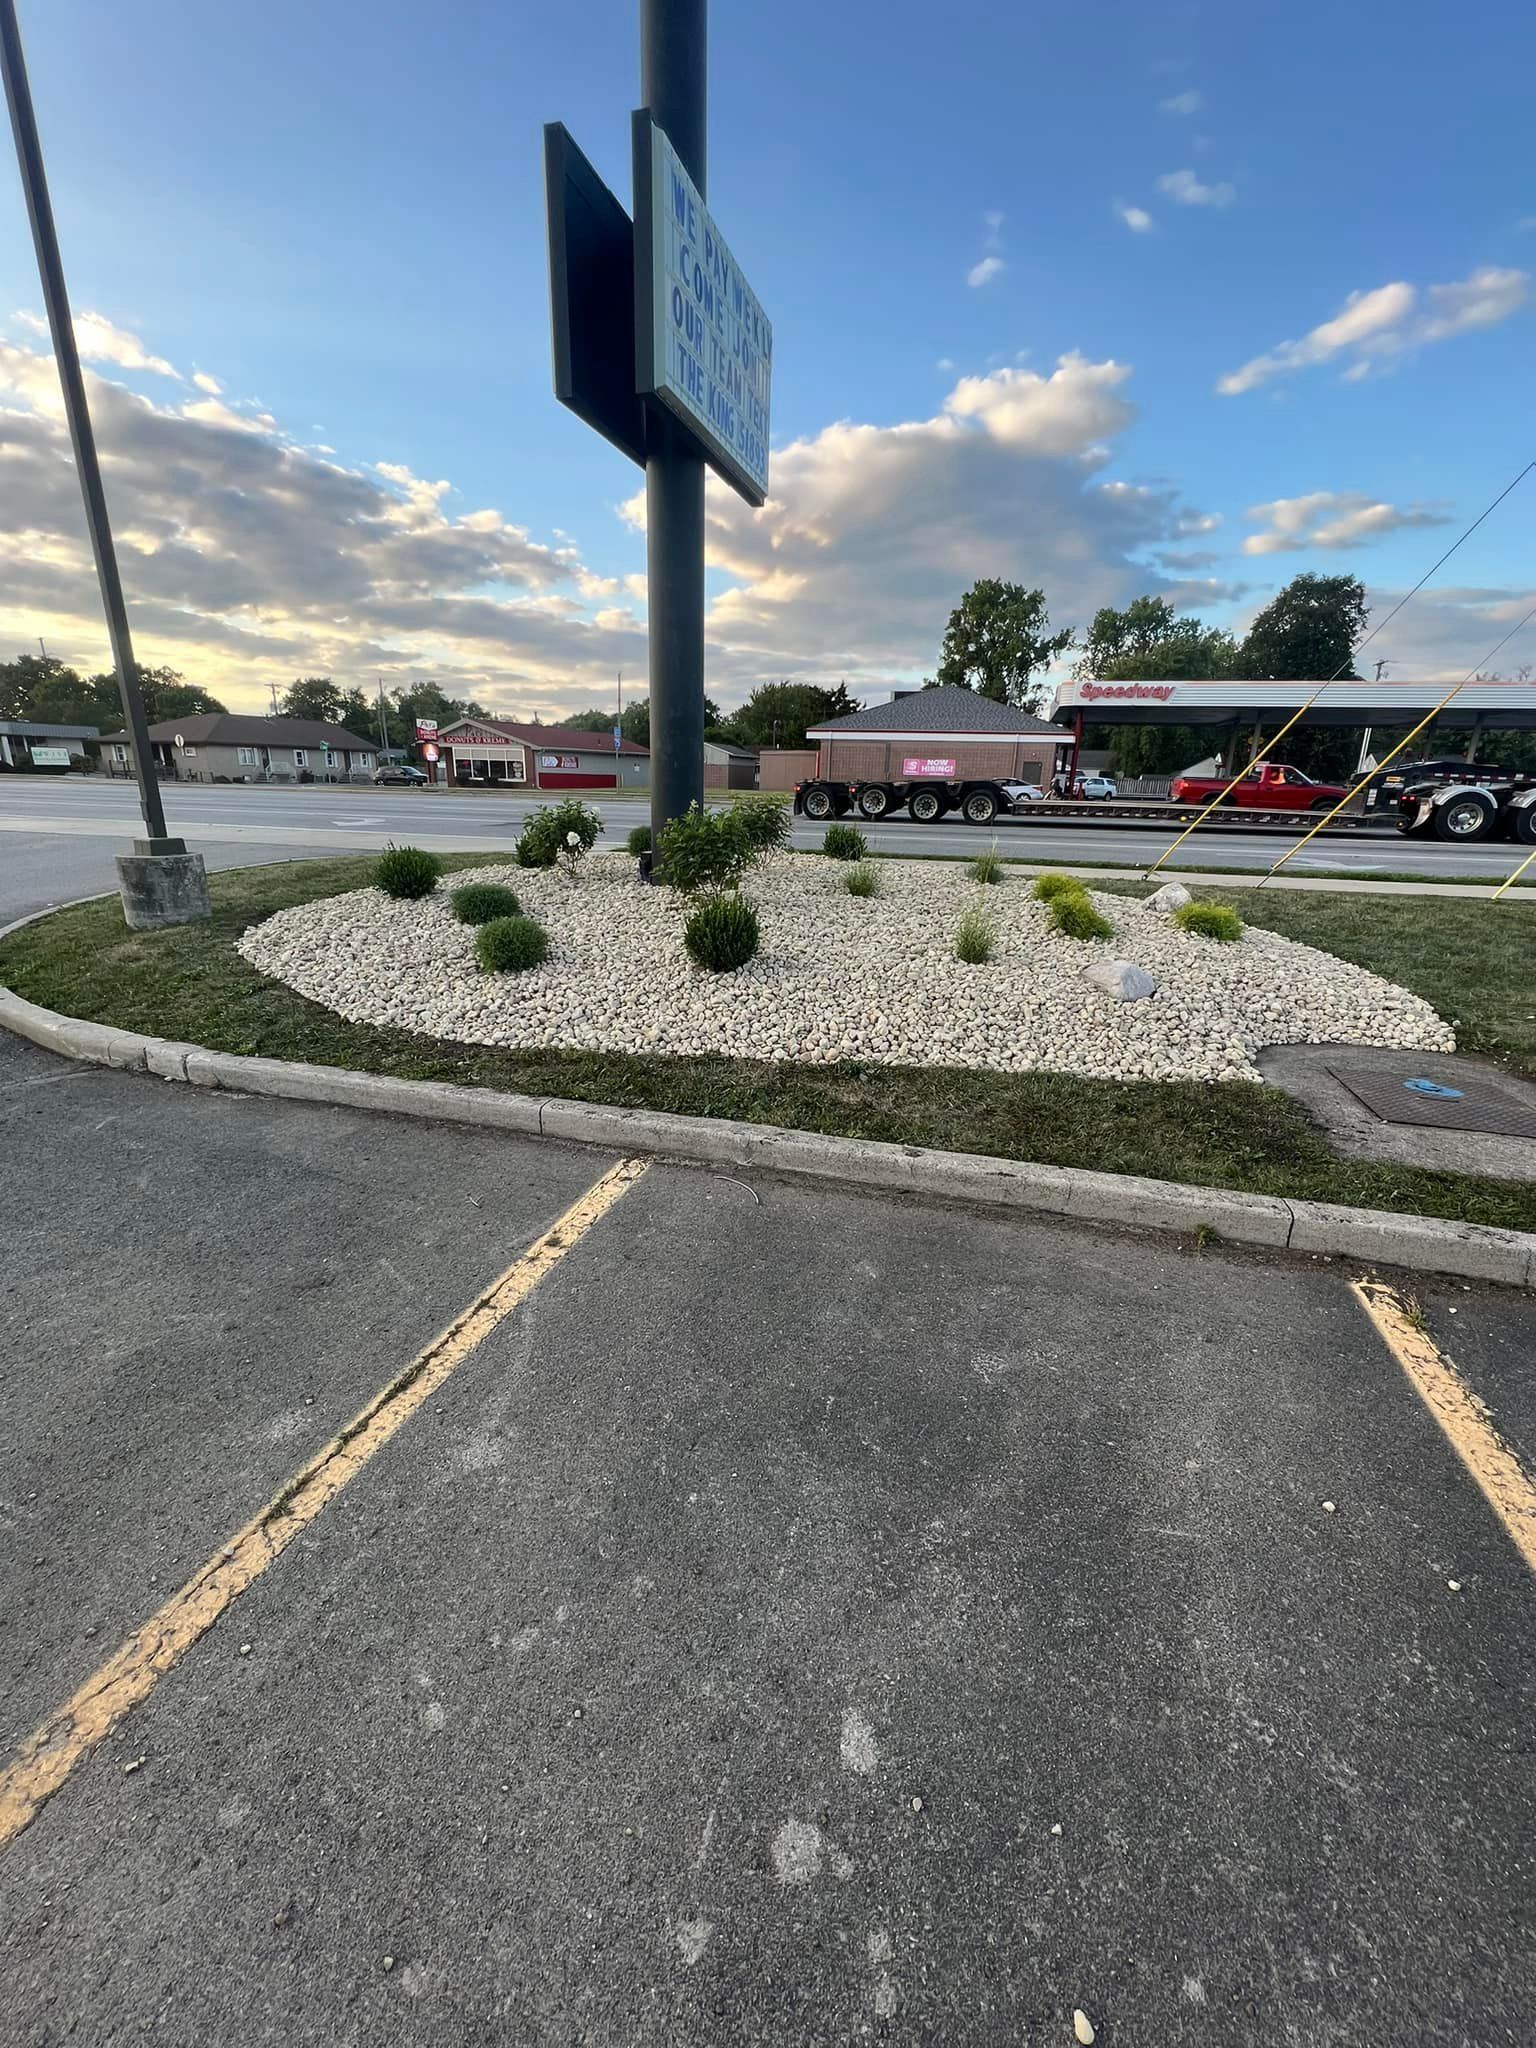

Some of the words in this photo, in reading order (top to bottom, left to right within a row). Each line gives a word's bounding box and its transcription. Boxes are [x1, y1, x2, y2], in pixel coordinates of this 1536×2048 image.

[673, 171, 696, 246] WE
[705, 226, 728, 297] PAY
[673, 285, 702, 355] OUR
[680, 242, 723, 337] COME
[678, 341, 703, 406] THE
[708, 380, 734, 441] KING
[1080, 682, 1176, 701] Speedway
